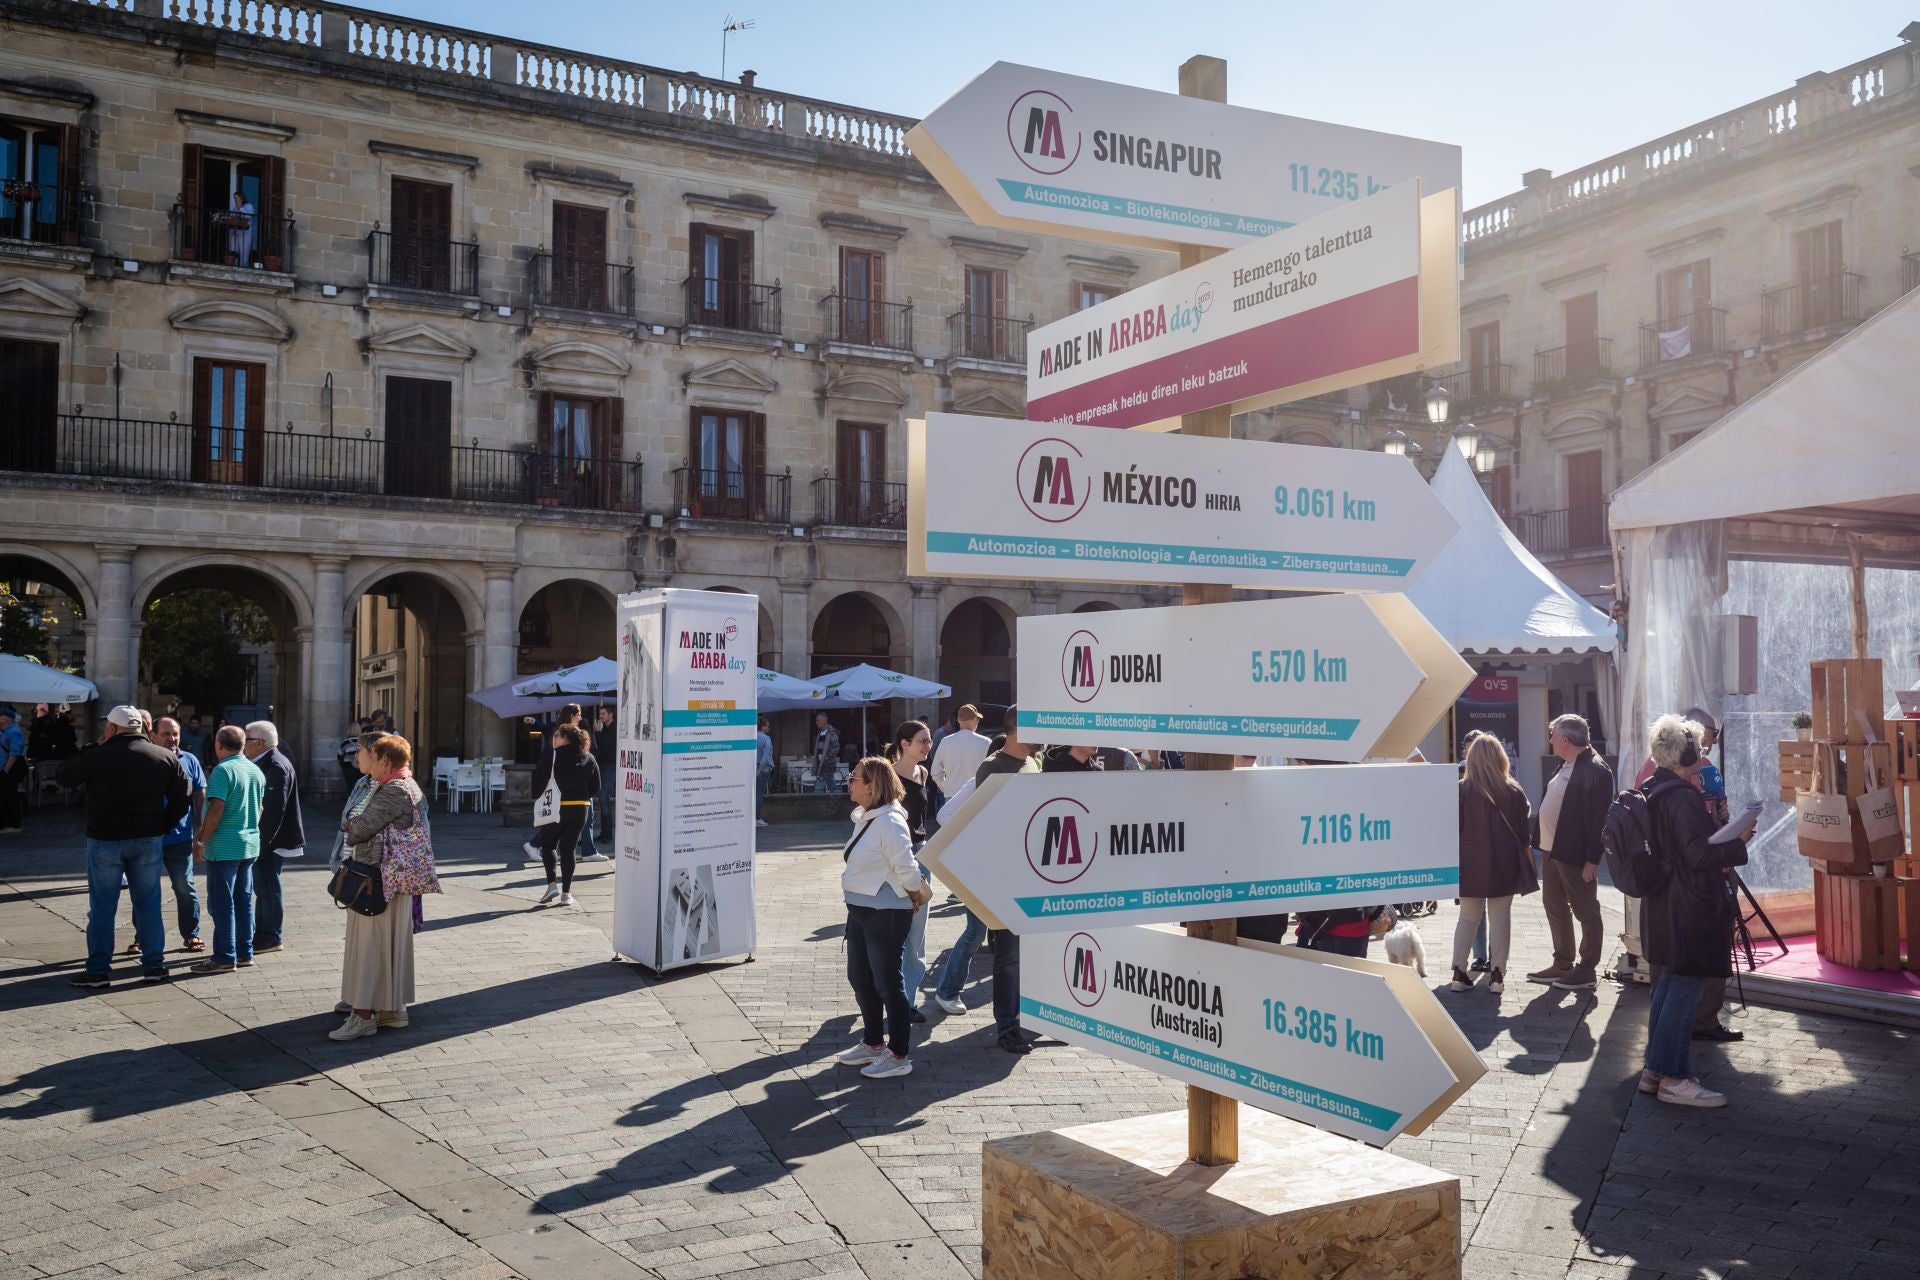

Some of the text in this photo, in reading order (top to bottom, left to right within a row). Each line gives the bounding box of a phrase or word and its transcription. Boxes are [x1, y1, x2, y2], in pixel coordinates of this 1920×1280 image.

[1093, 130, 1222, 180] SINGAPUR
[1289, 163, 1392, 201] 11.235 k
[1024, 186, 1110, 211] Automozioa
[1127, 202, 1221, 228] Bioteknologia
[1232, 225, 1373, 288] Hemengo talentua
[1233, 271, 1317, 312] mundurako
[1039, 303, 1203, 378] MADE IN ARABA day
[1076, 399, 1118, 423] enpresak
[1121, 389, 1148, 409] heldu
[1151, 382, 1178, 400] diren
[1181, 376, 1205, 393] leku
[1209, 360, 1248, 384] batzuk
[1103, 463, 1242, 512] MÉXICO HIRIA
[1274, 485, 1376, 522] 9.061 km
[967, 537, 1056, 556] Automozioa
[1075, 543, 1172, 564] Bioteknologia
[1188, 550, 1267, 567] Aeronautika
[679, 630, 726, 650] MADE IN
[691, 651, 747, 674] ARABA day
[1110, 654, 1162, 683] DUBAI
[1252, 649, 1347, 683] 5.570 km
[1036, 713, 1085, 726] Automoción
[1095, 715, 1157, 731] Biotecnología
[1168, 717, 1228, 732] Aeronáutica
[1110, 821, 1185, 856] MIAMI
[1300, 813, 1391, 845] 7.116 km
[1803, 811, 1840, 828] udapa
[1041, 895, 1125, 913] Automozioa
[1142, 885, 1232, 905] Bioteknologia
[1248, 880, 1322, 897] Aeronautika
[1113, 960, 1224, 1018] ARKAROOLA
[1039, 1005, 1087, 1031] Automozioa
[1097, 1024, 1161, 1057] Bioteknologia
[1172, 1048, 1236, 1079] Aeronautika
[1151, 1003, 1223, 1048] (Australia)
[1262, 998, 1384, 1061] 16.385 km
